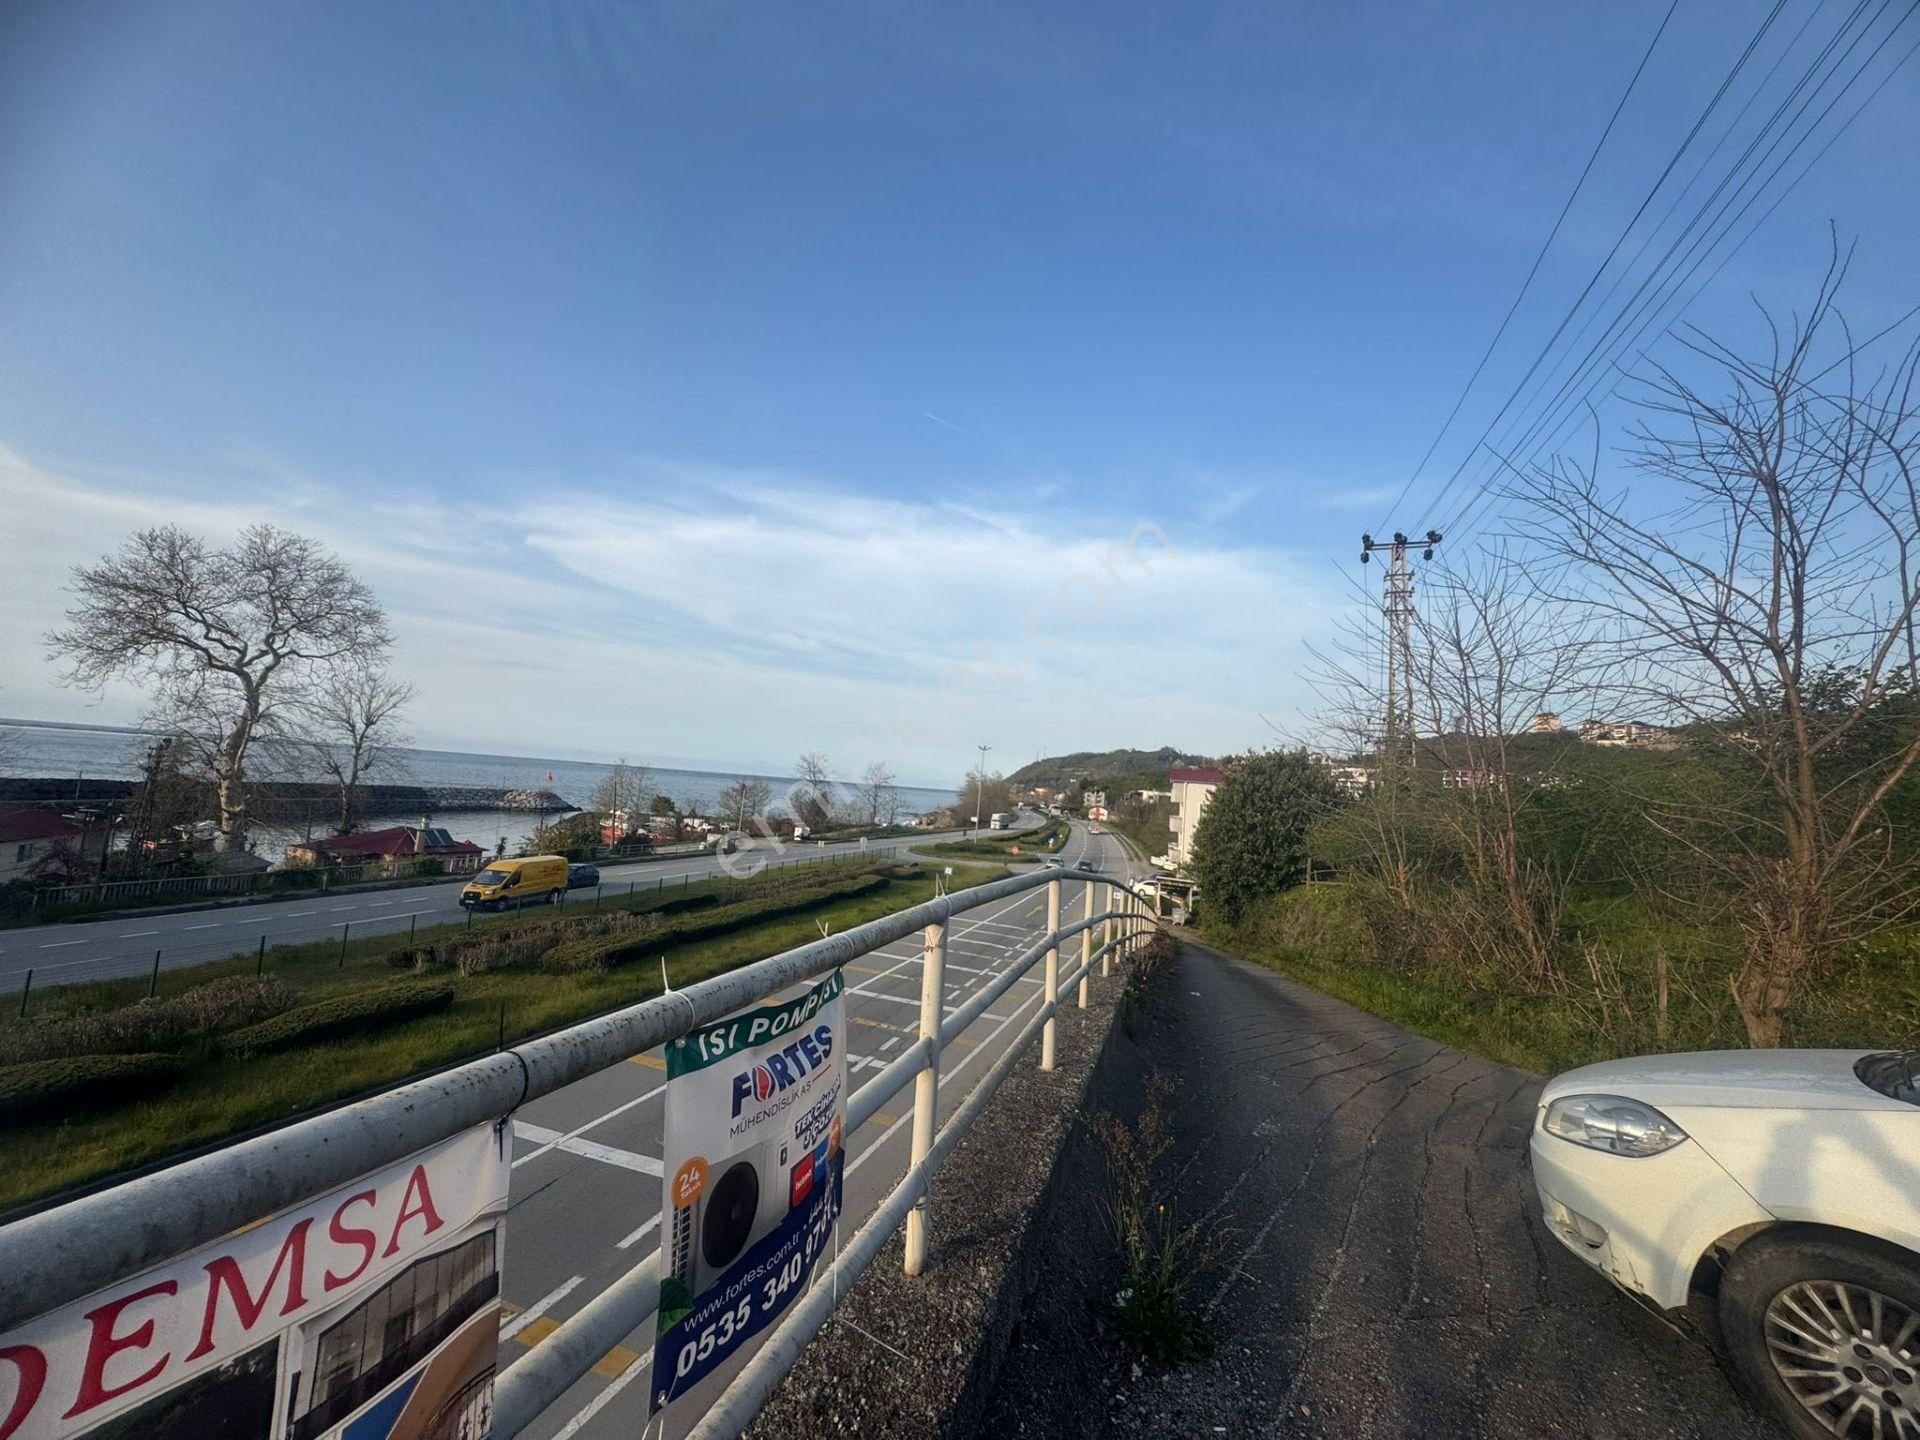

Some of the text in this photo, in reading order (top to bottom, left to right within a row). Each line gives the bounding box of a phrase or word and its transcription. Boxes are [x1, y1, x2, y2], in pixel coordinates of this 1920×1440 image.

[699, 1024, 738, 1061] ISI
[732, 1025, 832, 1119] FORTES
[730, 1088, 800, 1138] MÜHENDİSLİK
[679, 1166, 701, 1192] 24
[677, 1294, 751, 1377] 0535
[762, 1252, 801, 1311] 340
[684, 1231, 800, 1332] www.fortes.com.tr
